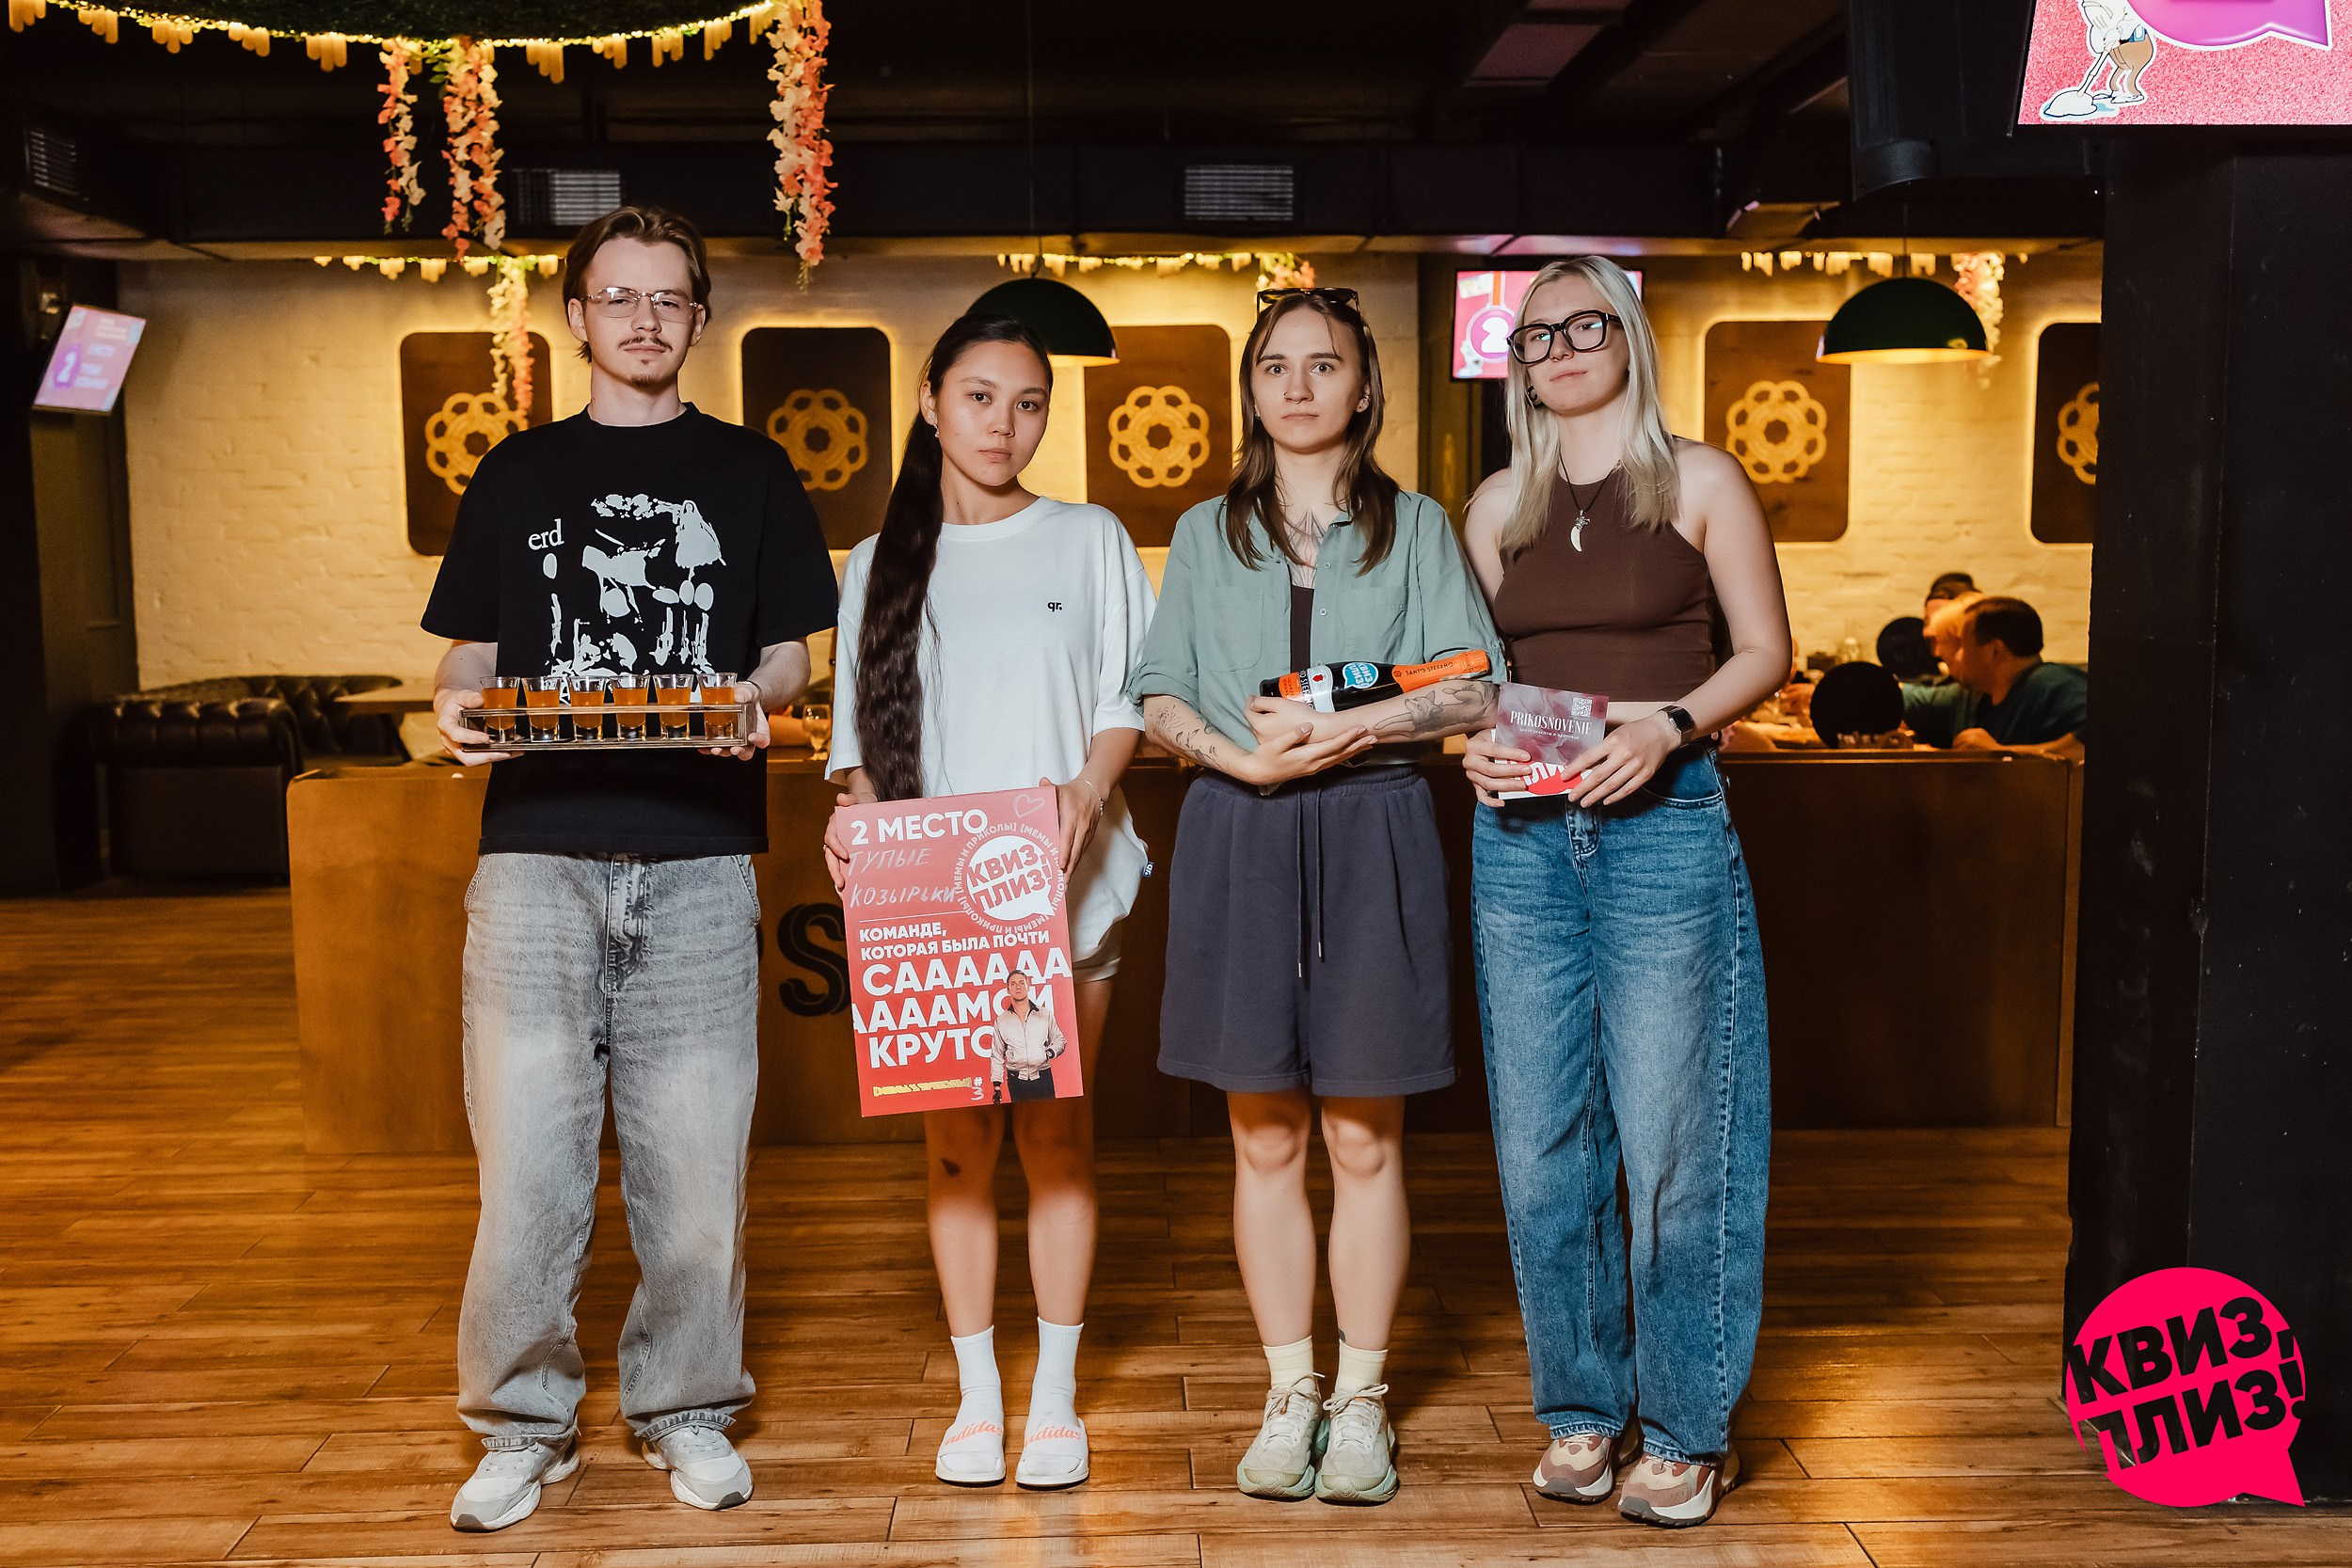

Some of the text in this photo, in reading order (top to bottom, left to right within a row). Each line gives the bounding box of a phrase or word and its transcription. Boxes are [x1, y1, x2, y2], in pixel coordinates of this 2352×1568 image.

[528, 518, 564, 550] erd
[1510, 710, 1593, 736] PRIKOSNOVENIE
[850, 809, 988, 846] 2 МЕСТО
[848, 847, 932, 877] ТУПЫЕ
[850, 883, 957, 909] КОЗЫРЬКИ
[972, 864, 1052, 911] ПЛИЗ!
[859, 922, 947, 942] КОМАНДЕ,
[860, 929, 1050, 961] КОТОРАЯ БЫЛА ПОЧТИ
[945, 1420, 1003, 1447] adidas
[1024, 1425, 1082, 1449] adidas
